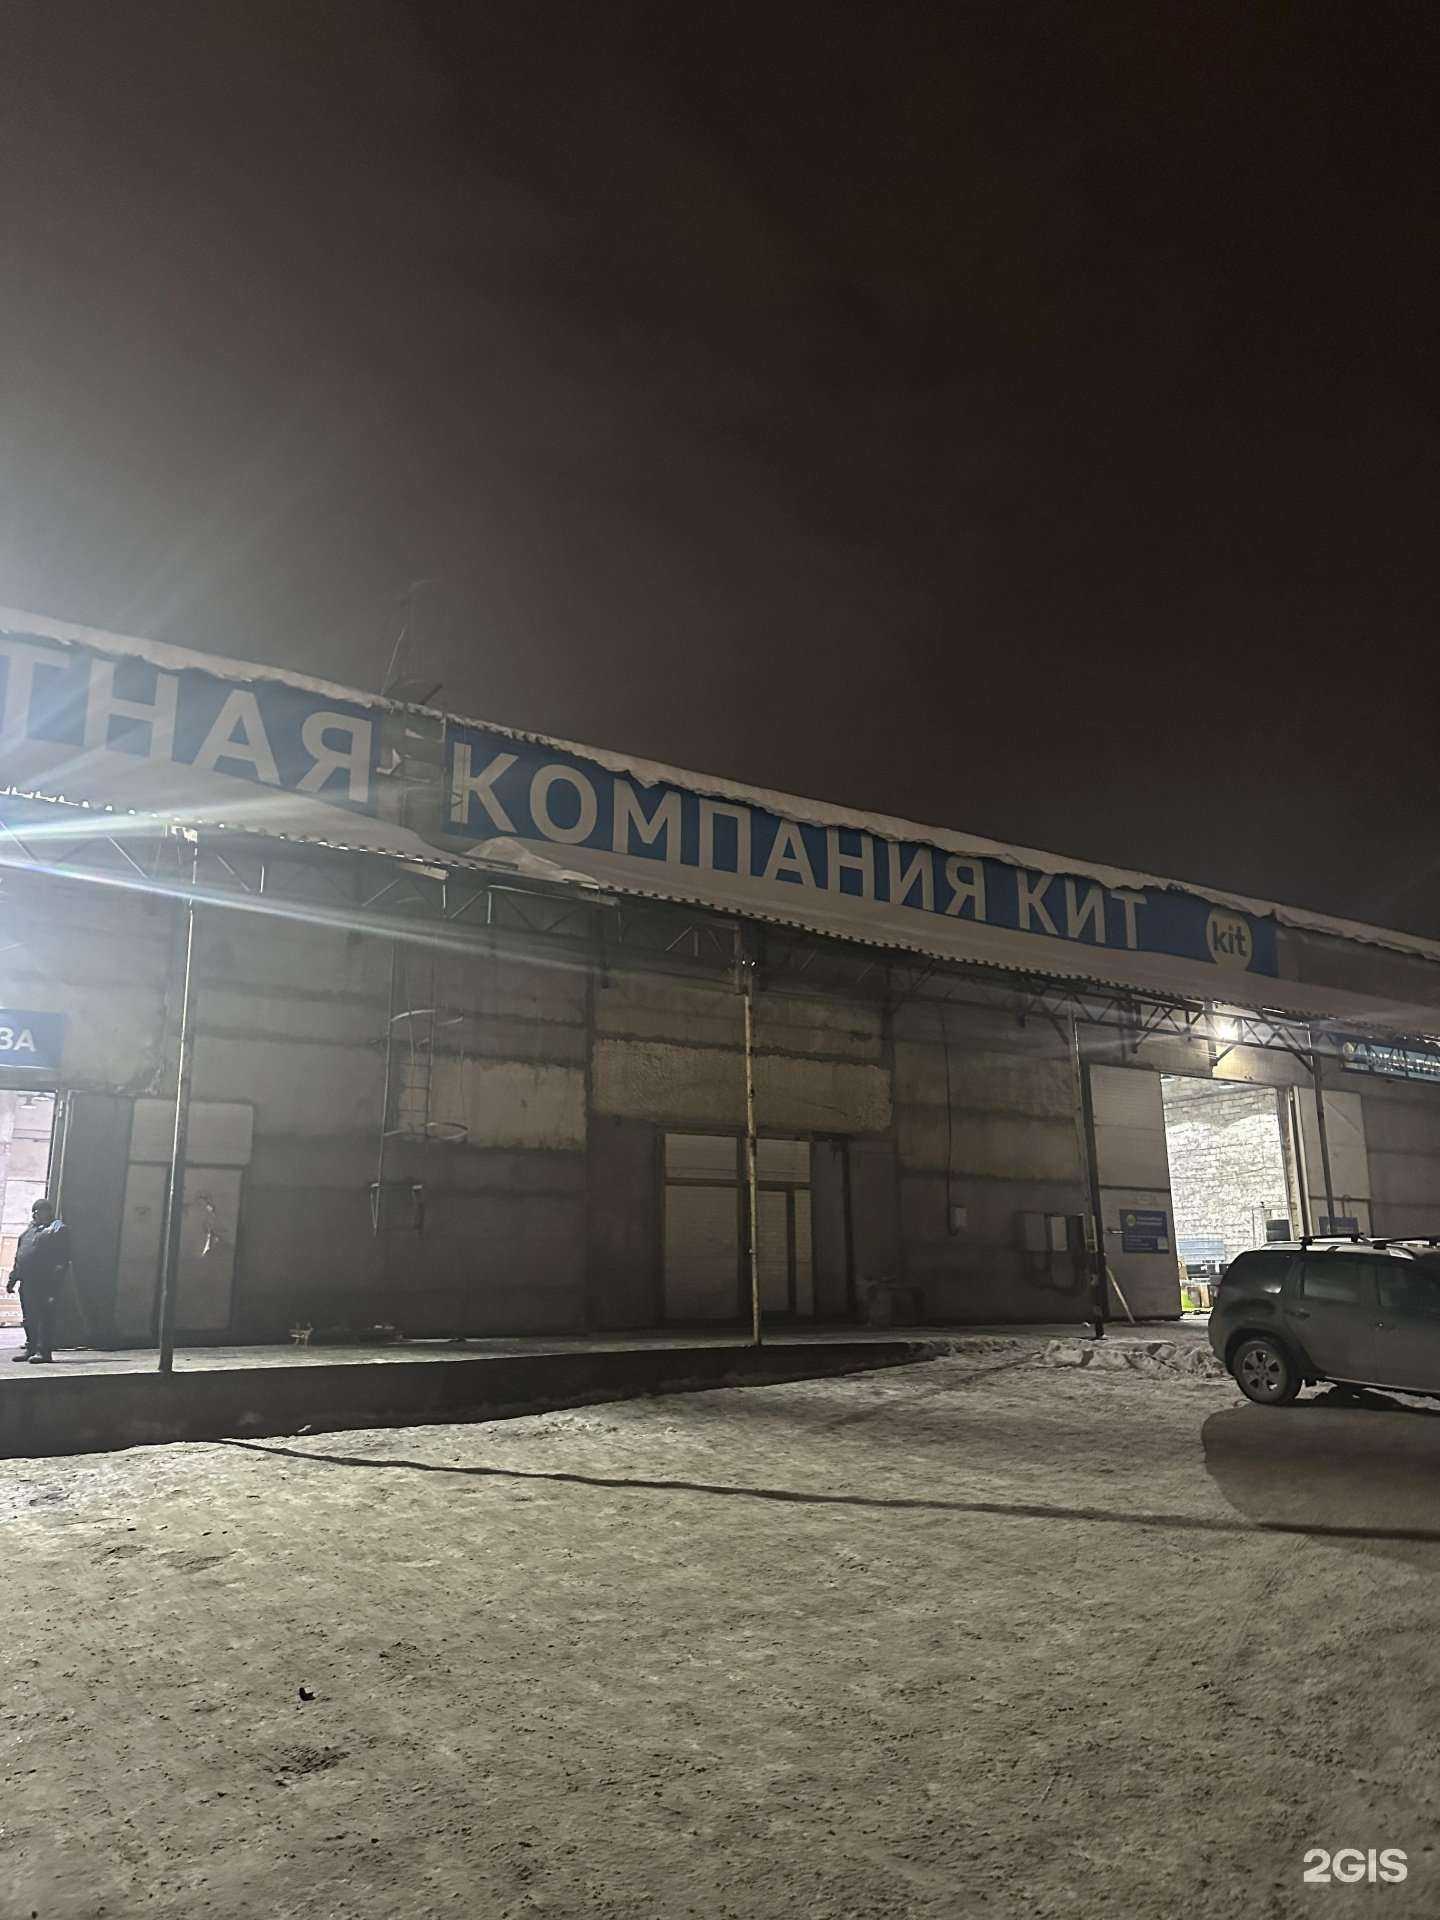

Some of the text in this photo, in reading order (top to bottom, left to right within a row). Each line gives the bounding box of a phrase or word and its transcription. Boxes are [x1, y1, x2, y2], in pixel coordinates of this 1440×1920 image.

[449, 742, 987, 922] КОМПАНИЯ
[1018, 868, 1147, 949] КИТ
[1213, 922, 1247, 957] kit
